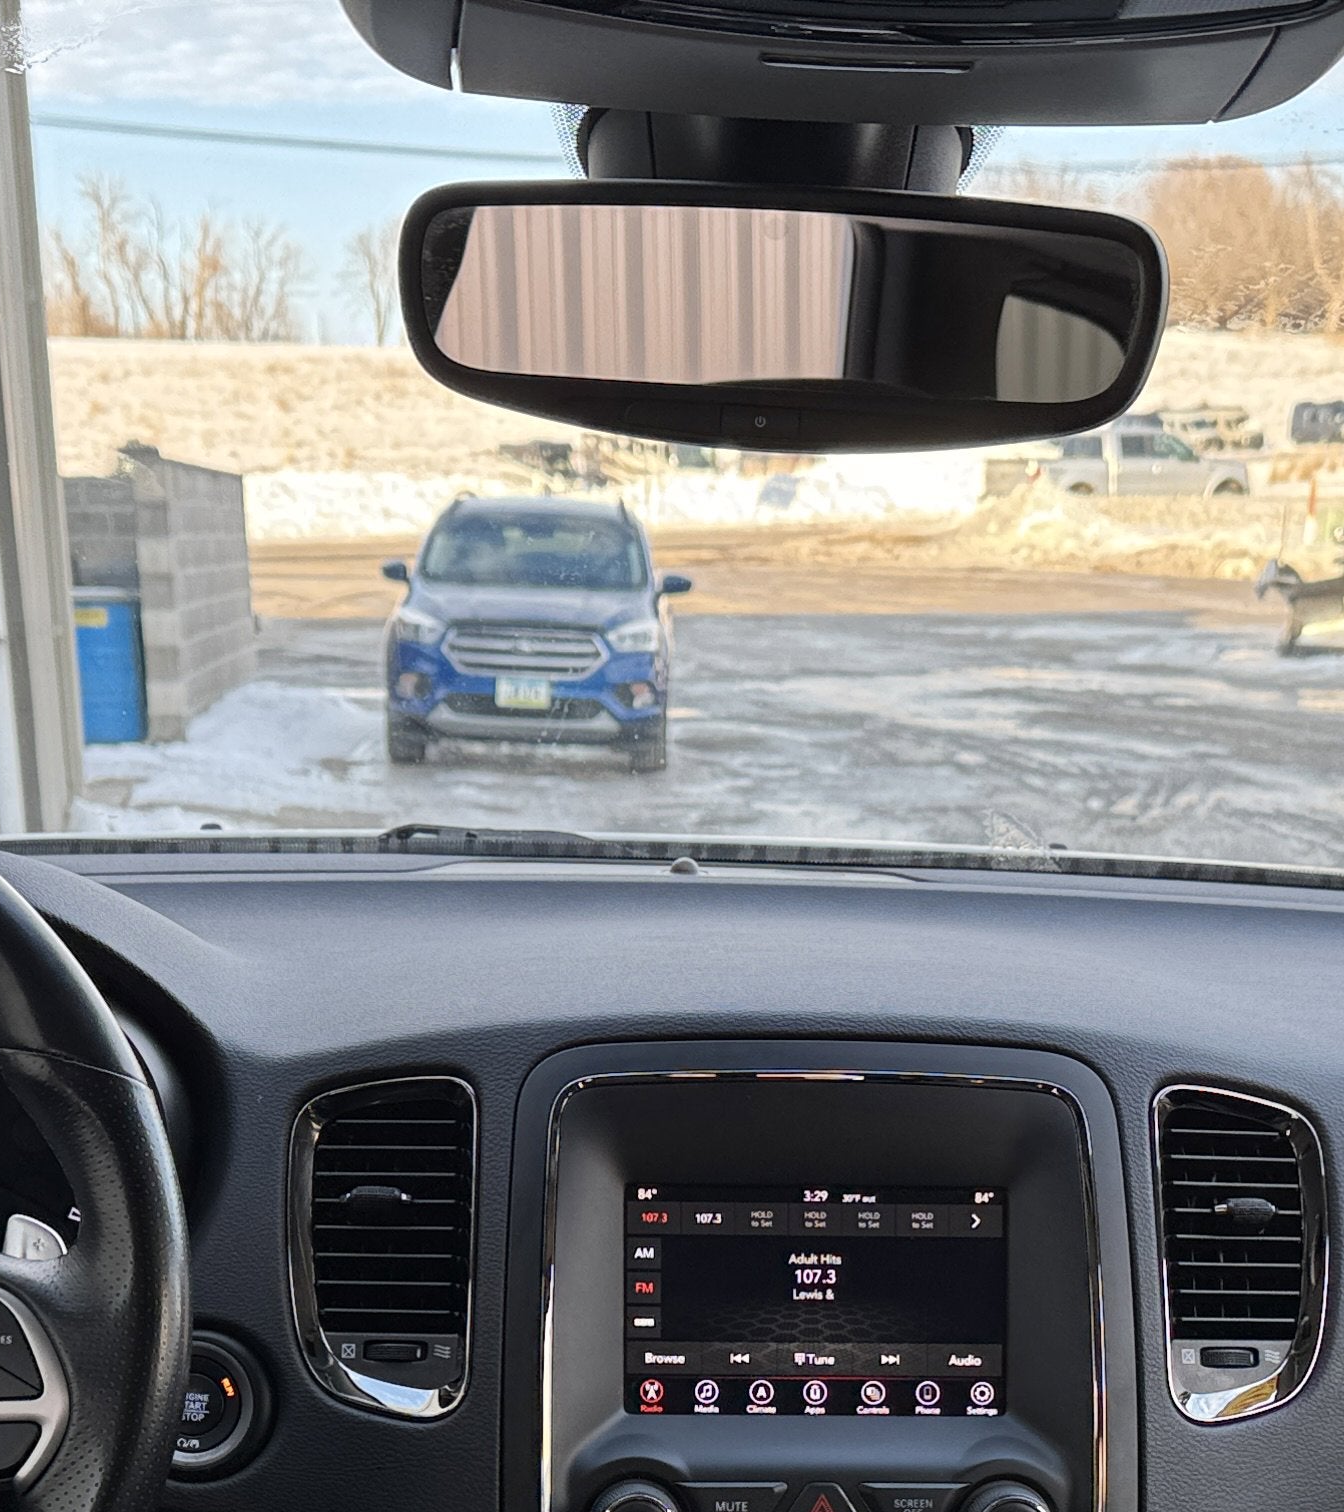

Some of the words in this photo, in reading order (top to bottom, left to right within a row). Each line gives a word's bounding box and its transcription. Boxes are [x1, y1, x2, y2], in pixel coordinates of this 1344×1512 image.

[637, 1188, 658, 1200] 84°
[803, 1190, 829, 1202] 3:29
[974, 1192, 995, 1204] 84°
[641, 1212, 669, 1223] 107.3
[695, 1213, 722, 1224] 107.3
[750, 1210, 774, 1219] HOLD
[804, 1211, 827, 1220] HOLD
[858, 1211, 881, 1220] HOLD
[911, 1212, 934, 1220] HOLD
[760, 1219, 773, 1228] Set
[814, 1219, 826, 1228] Set
[868, 1220, 880, 1229] Set
[921, 1221, 934, 1229] Set
[634, 1247, 655, 1259] AM
[788, 1253, 818, 1265] Adult
[820, 1253, 842, 1265] Hits
[794, 1268, 837, 1284] 107.3
[635, 1282, 655, 1294] FM
[792, 1288, 823, 1300] Lewis
[826, 1290, 835, 1300] &
[644, 1352, 686, 1365] Browse
[806, 1353, 836, 1366] Tune
[948, 1354, 983, 1367] Audio
[640, 1404, 664, 1413] Radio
[693, 1404, 720, 1414] Media
[746, 1404, 777, 1414] Climate
[804, 1405, 826, 1415] Apps
[856, 1405, 890, 1415] Controls
[915, 1405, 942, 1415] Phone
[966, 1405, 999, 1416] Settings
[715, 1501, 749, 1512] MUTE
[894, 1499, 934, 1510] SCREEN
